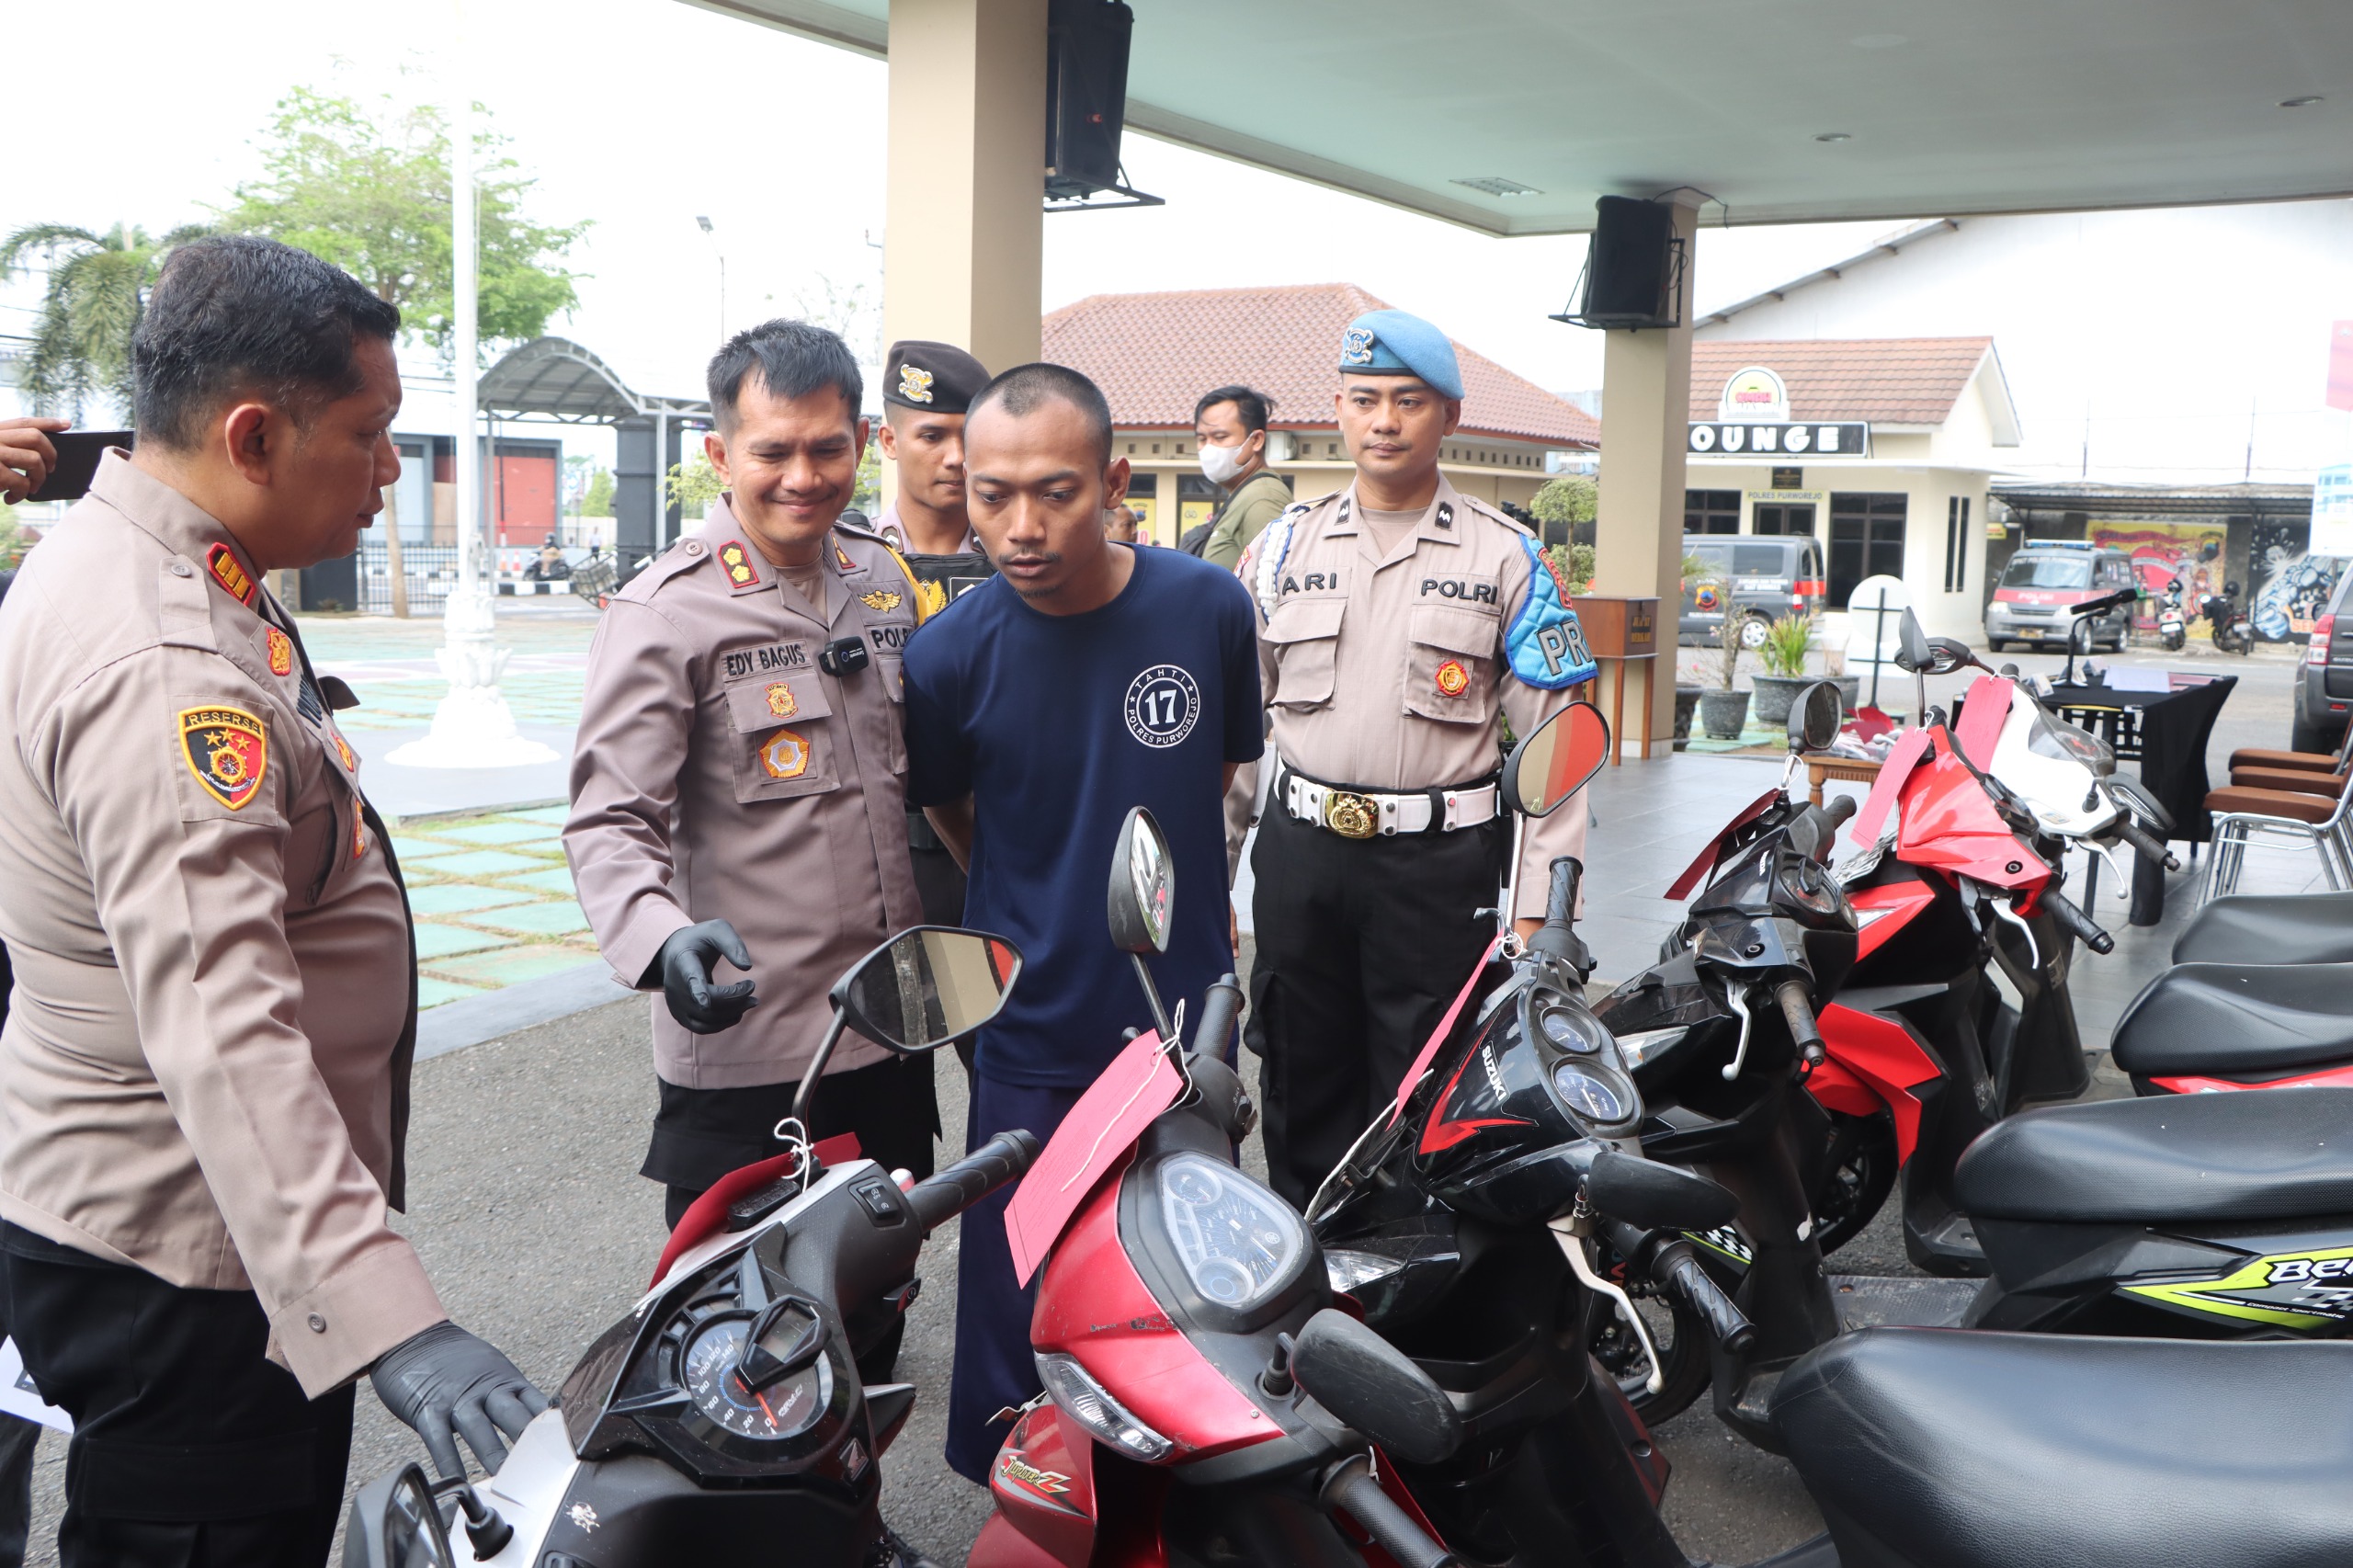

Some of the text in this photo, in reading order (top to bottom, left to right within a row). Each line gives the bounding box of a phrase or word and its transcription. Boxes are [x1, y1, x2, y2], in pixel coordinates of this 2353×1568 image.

[1748, 491, 1823, 500] POLRES PURWOREJO
[1282, 573, 1336, 596] ARI
[1421, 579, 1497, 605] POLRI
[726, 643, 806, 676] EDY BAGUS
[1135, 668, 1186, 688] TAHTI
[1144, 689, 1176, 725] 17
[188, 711, 258, 731] RESERSE
[1128, 697, 1197, 744] POLRES PURWOREJO
[1482, 1045, 1507, 1101] SUZUKI
[708, 1346, 722, 1362] 120
[722, 1344, 734, 1359] 140
[698, 1361, 710, 1377] 100
[699, 1380, 710, 1394] 80
[723, 1407, 735, 1422] 40
[743, 1415, 754, 1429] 20
[764, 1417, 772, 1427] 0
